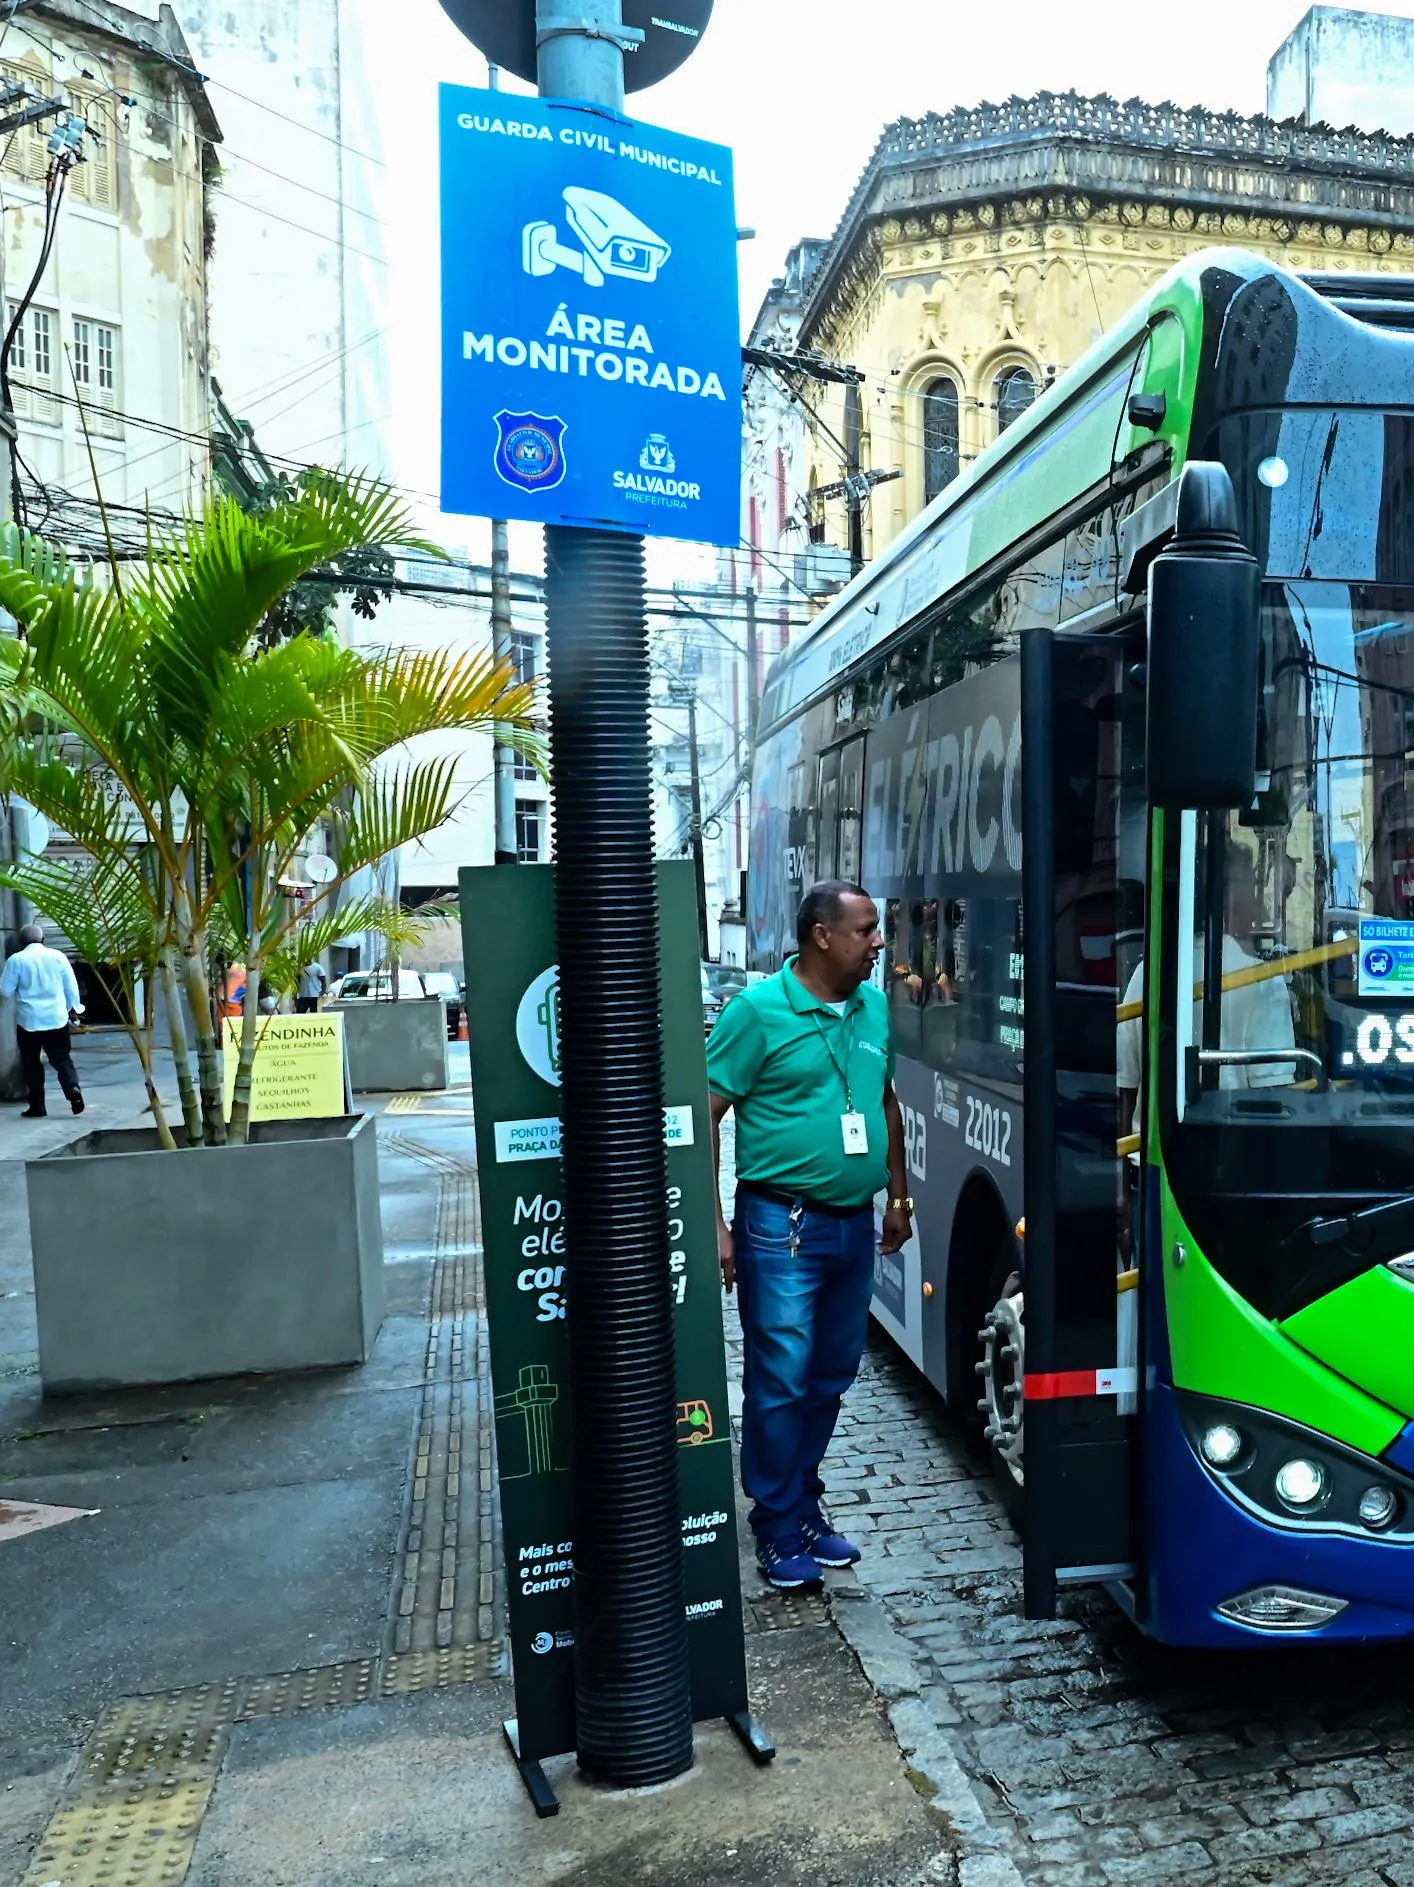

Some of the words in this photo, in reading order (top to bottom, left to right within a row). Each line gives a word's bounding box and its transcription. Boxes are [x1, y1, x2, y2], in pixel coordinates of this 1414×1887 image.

[457, 113, 554, 143] GUARDA
[559, 128, 615, 155] CIVIL
[619, 143, 722, 186] MUNICIPAL
[546, 302, 654, 354] ÁREA
[462, 331, 726, 401] MONITORADA
[613, 471, 700, 500] SALVADOR
[625, 492, 687, 509] PREFEITURA
[1363, 924, 1375, 936] SÓ
[1376, 926, 1408, 937] BILHETE
[230, 1027, 336, 1043] FENDINHA
[281, 1042, 293, 1050] DE
[294, 1041, 329, 1049] FAZENDA
[271, 1059, 297, 1068] ÁGUA
[258, 1087, 310, 1097] SEQUILHOS
[256, 1100, 312, 1111] CASTANHAS
[511, 1126, 548, 1139] PONTO
[965, 1095, 1012, 1167] 22012
[508, 1141, 547, 1154] PRAÇA
[519, 1543, 554, 1561] Mais
[520, 1566, 530, 1579] e
[532, 1564, 542, 1576] o
[522, 1577, 571, 1595] Centro
[685, 1599, 723, 1616] LVADOR
